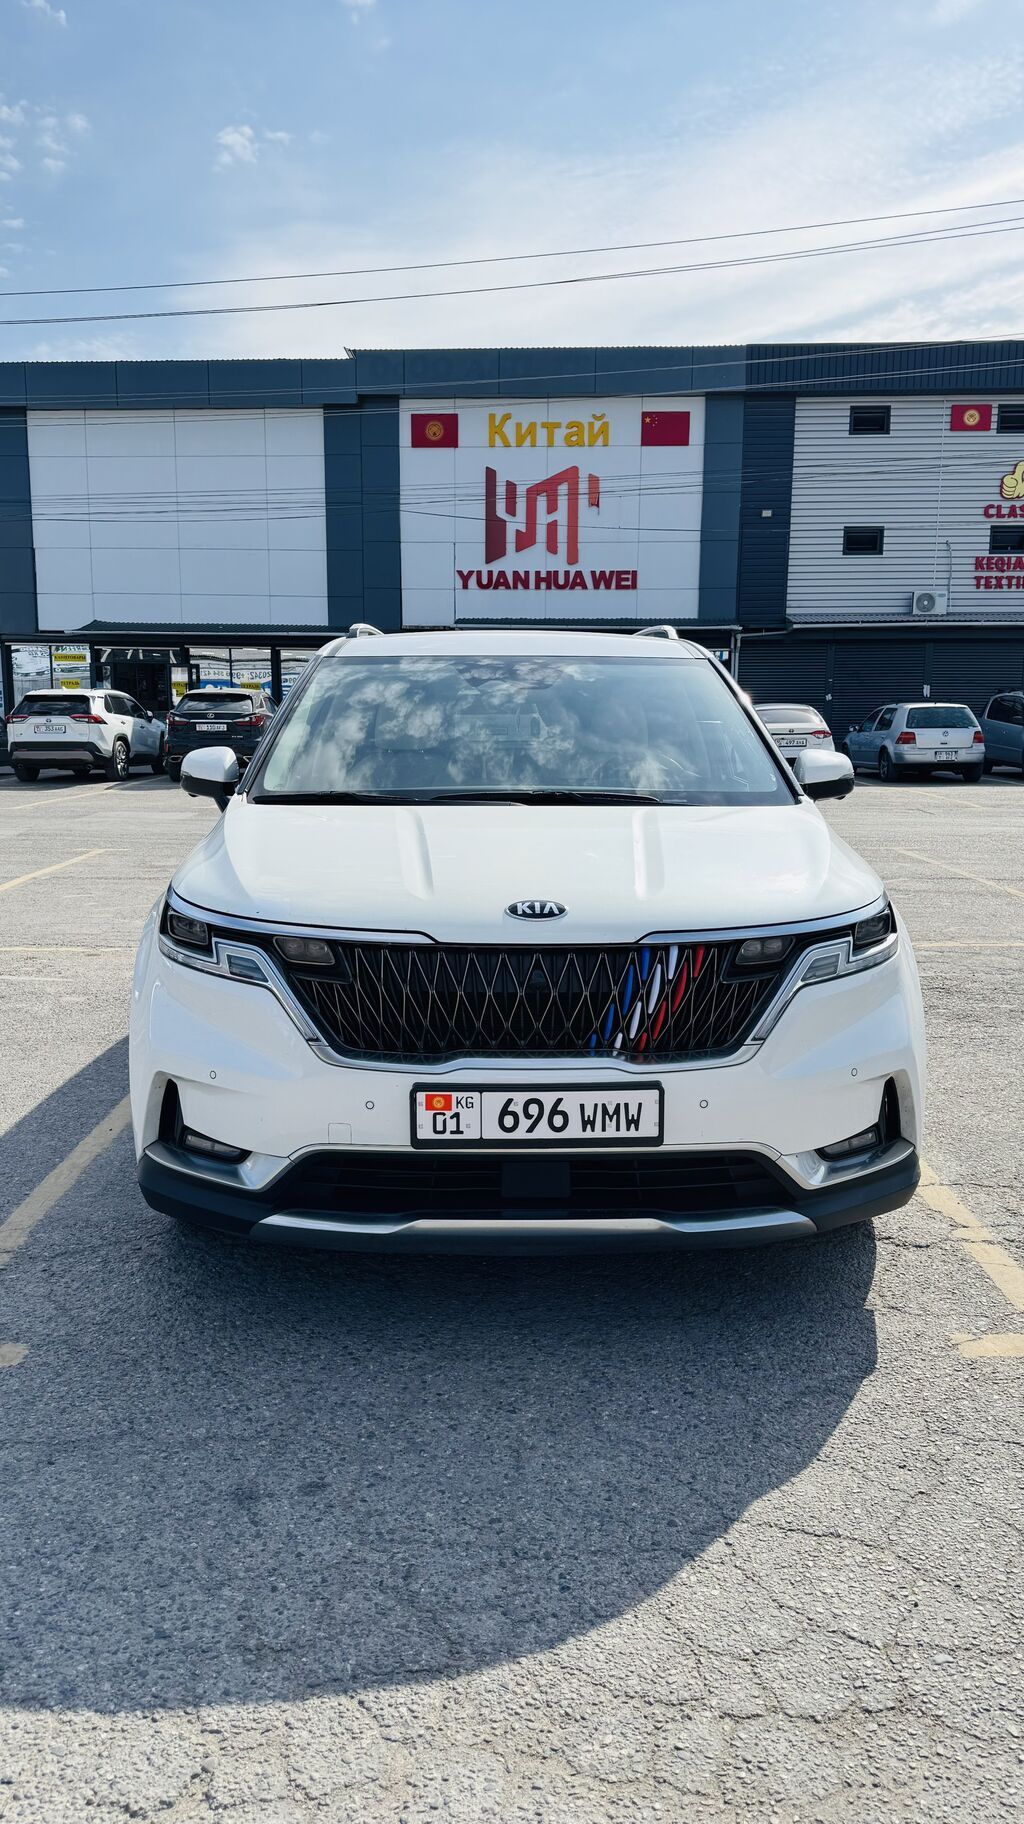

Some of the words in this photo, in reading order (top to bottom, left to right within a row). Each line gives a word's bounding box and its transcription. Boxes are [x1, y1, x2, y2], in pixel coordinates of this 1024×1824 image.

[488, 412, 610, 447] Китай
[457, 570, 530, 590] YUAN
[534, 570, 588, 590] HUA
[591, 570, 638, 590] WEI
[516, 902, 560, 914] KIA
[455, 1096, 474, 1109] KG
[432, 1111, 464, 1135] 01
[498, 1097, 569, 1133] 696
[580, 1102, 642, 1132] WMW
